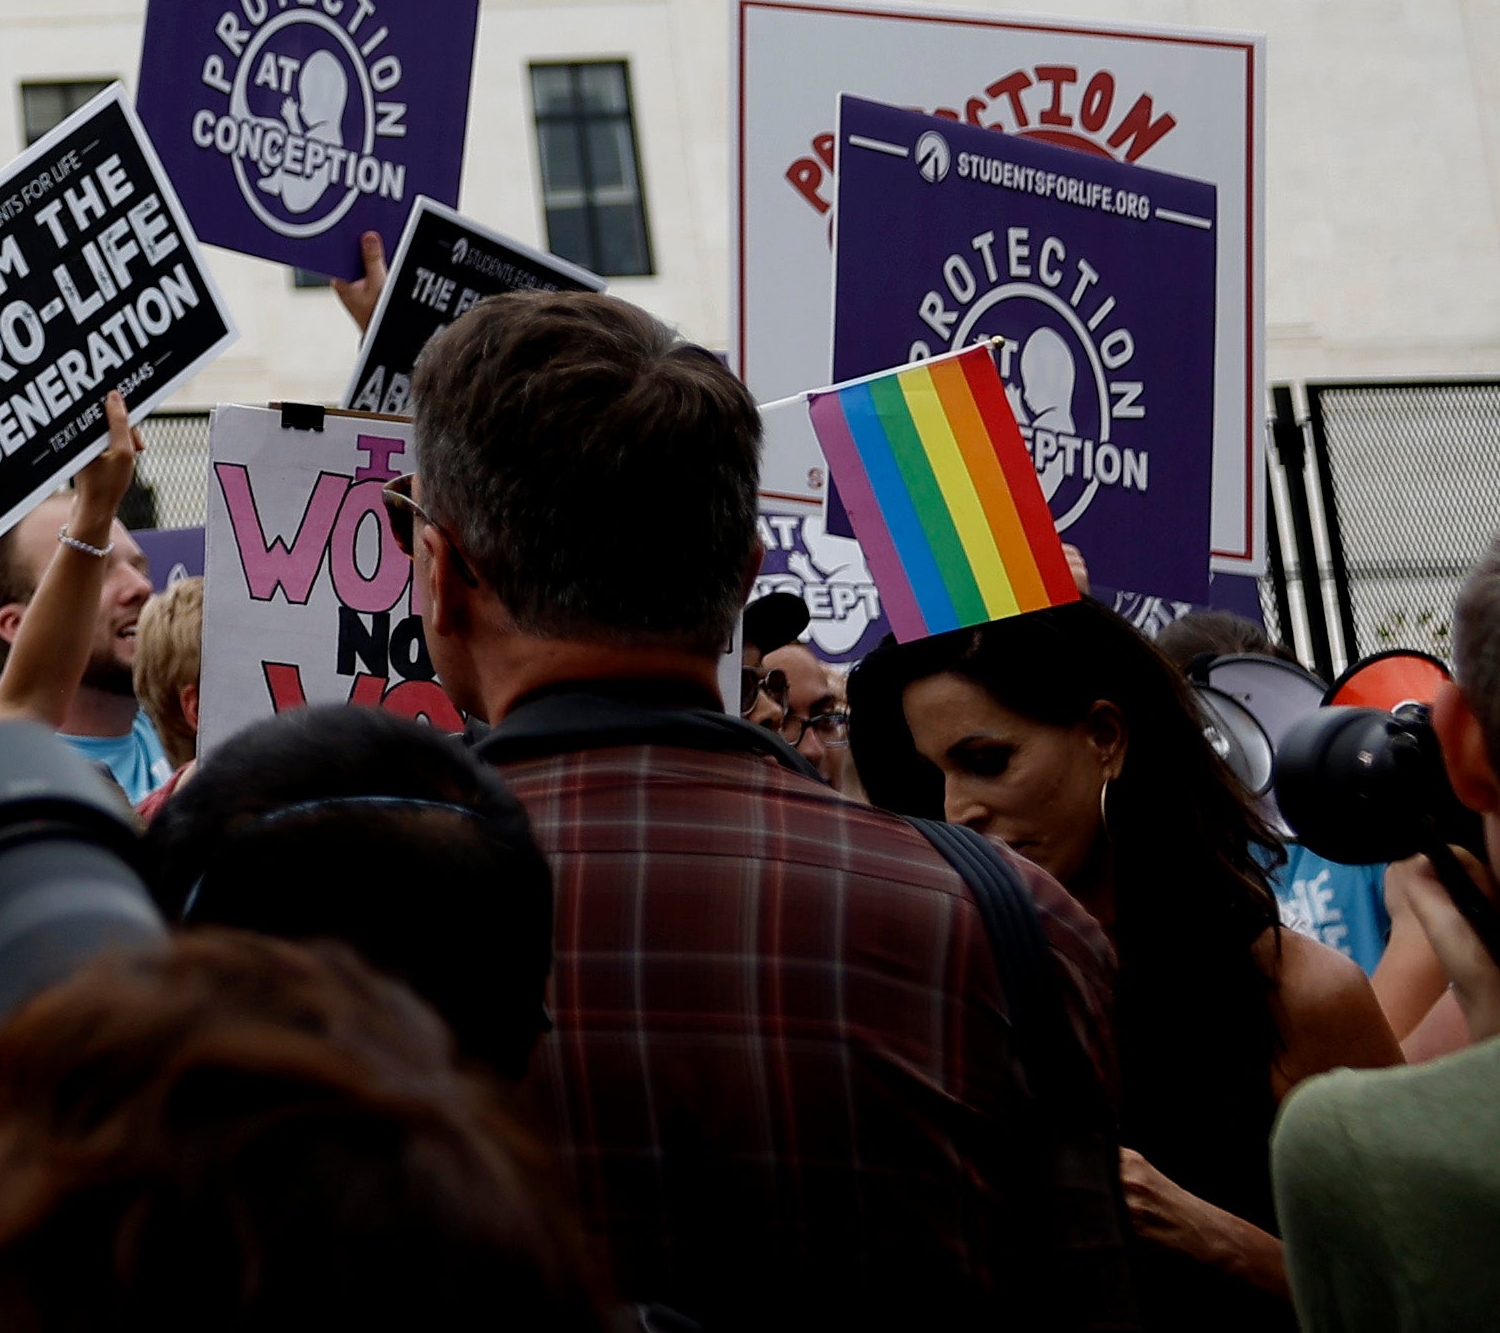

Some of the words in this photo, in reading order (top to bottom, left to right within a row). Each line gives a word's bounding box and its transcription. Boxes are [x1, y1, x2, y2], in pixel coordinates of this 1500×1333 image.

[254, 51, 300, 94] AT
[20, 169, 54, 207] FOR
[50, 149, 83, 183] LIFE
[192, 108, 407, 202] CONCEPTION
[34, 153, 136, 249] THE
[957, 152, 1150, 222] STUDENTSFORLIFE.ORG
[411, 266, 458, 314] THE
[48, 418, 79, 453] TEXT
[74, 404, 105, 433] LIFE
